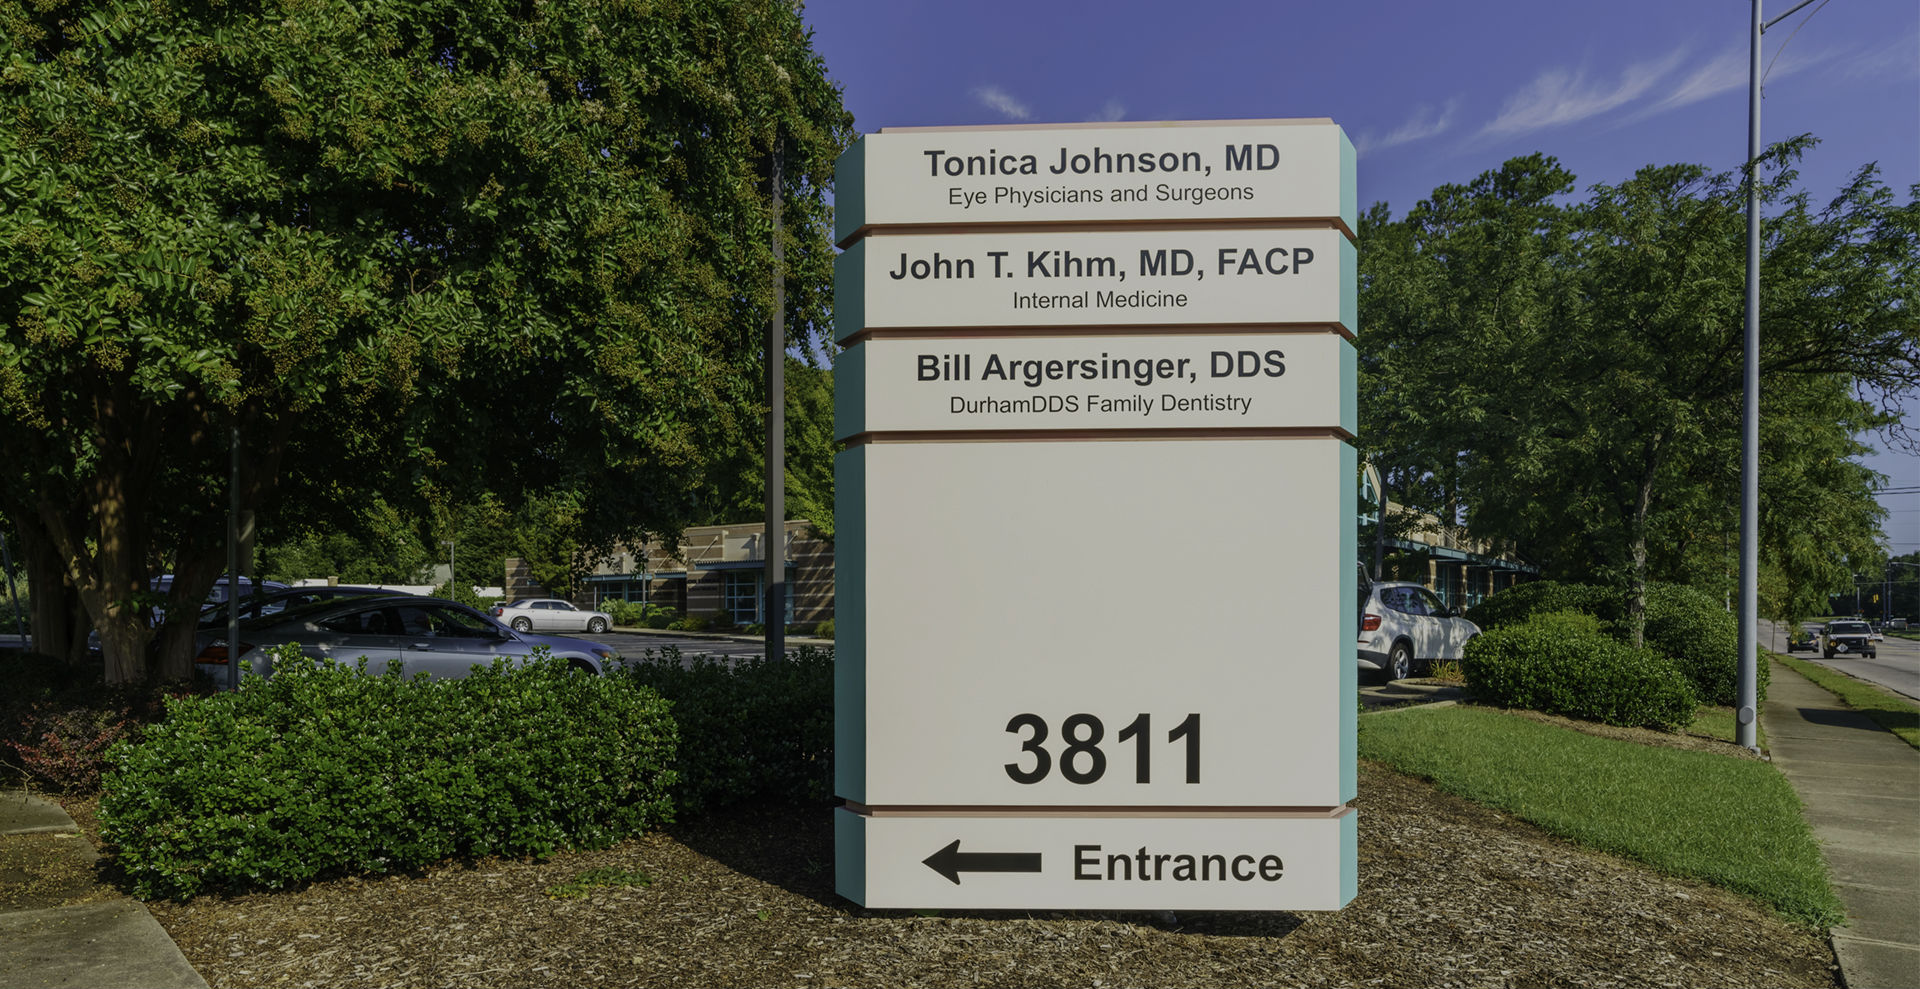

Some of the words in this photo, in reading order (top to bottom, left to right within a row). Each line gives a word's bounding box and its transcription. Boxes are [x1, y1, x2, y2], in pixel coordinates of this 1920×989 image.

[923, 148, 1038, 177] Tonica
[1049, 146, 1211, 177] Johnson,
[1225, 143, 1280, 172] MD
[949, 187, 987, 210] Eye
[994, 185, 1104, 209] Physicians
[1110, 184, 1148, 203] and
[1155, 183, 1254, 206] Surgeons
[889, 252, 975, 281] John
[986, 251, 1014, 279] T.
[1027, 250, 1126, 283] Kihm,
[1139, 249, 1204, 282] MD,
[1218, 247, 1315, 276] FACP
[1013, 290, 1089, 309] Internal
[1096, 289, 1188, 308] Medicine
[917, 353, 971, 382] Bill
[981, 352, 1197, 388] Argersinger,
[1210, 349, 1286, 378] DDS
[950, 394, 1079, 414] DurhamDDS
[1087, 394, 1154, 417] Family
[1161, 393, 1252, 416] Dentistry
[1003, 712, 1201, 786] 3811
[1073, 843, 1284, 882] Entrance
